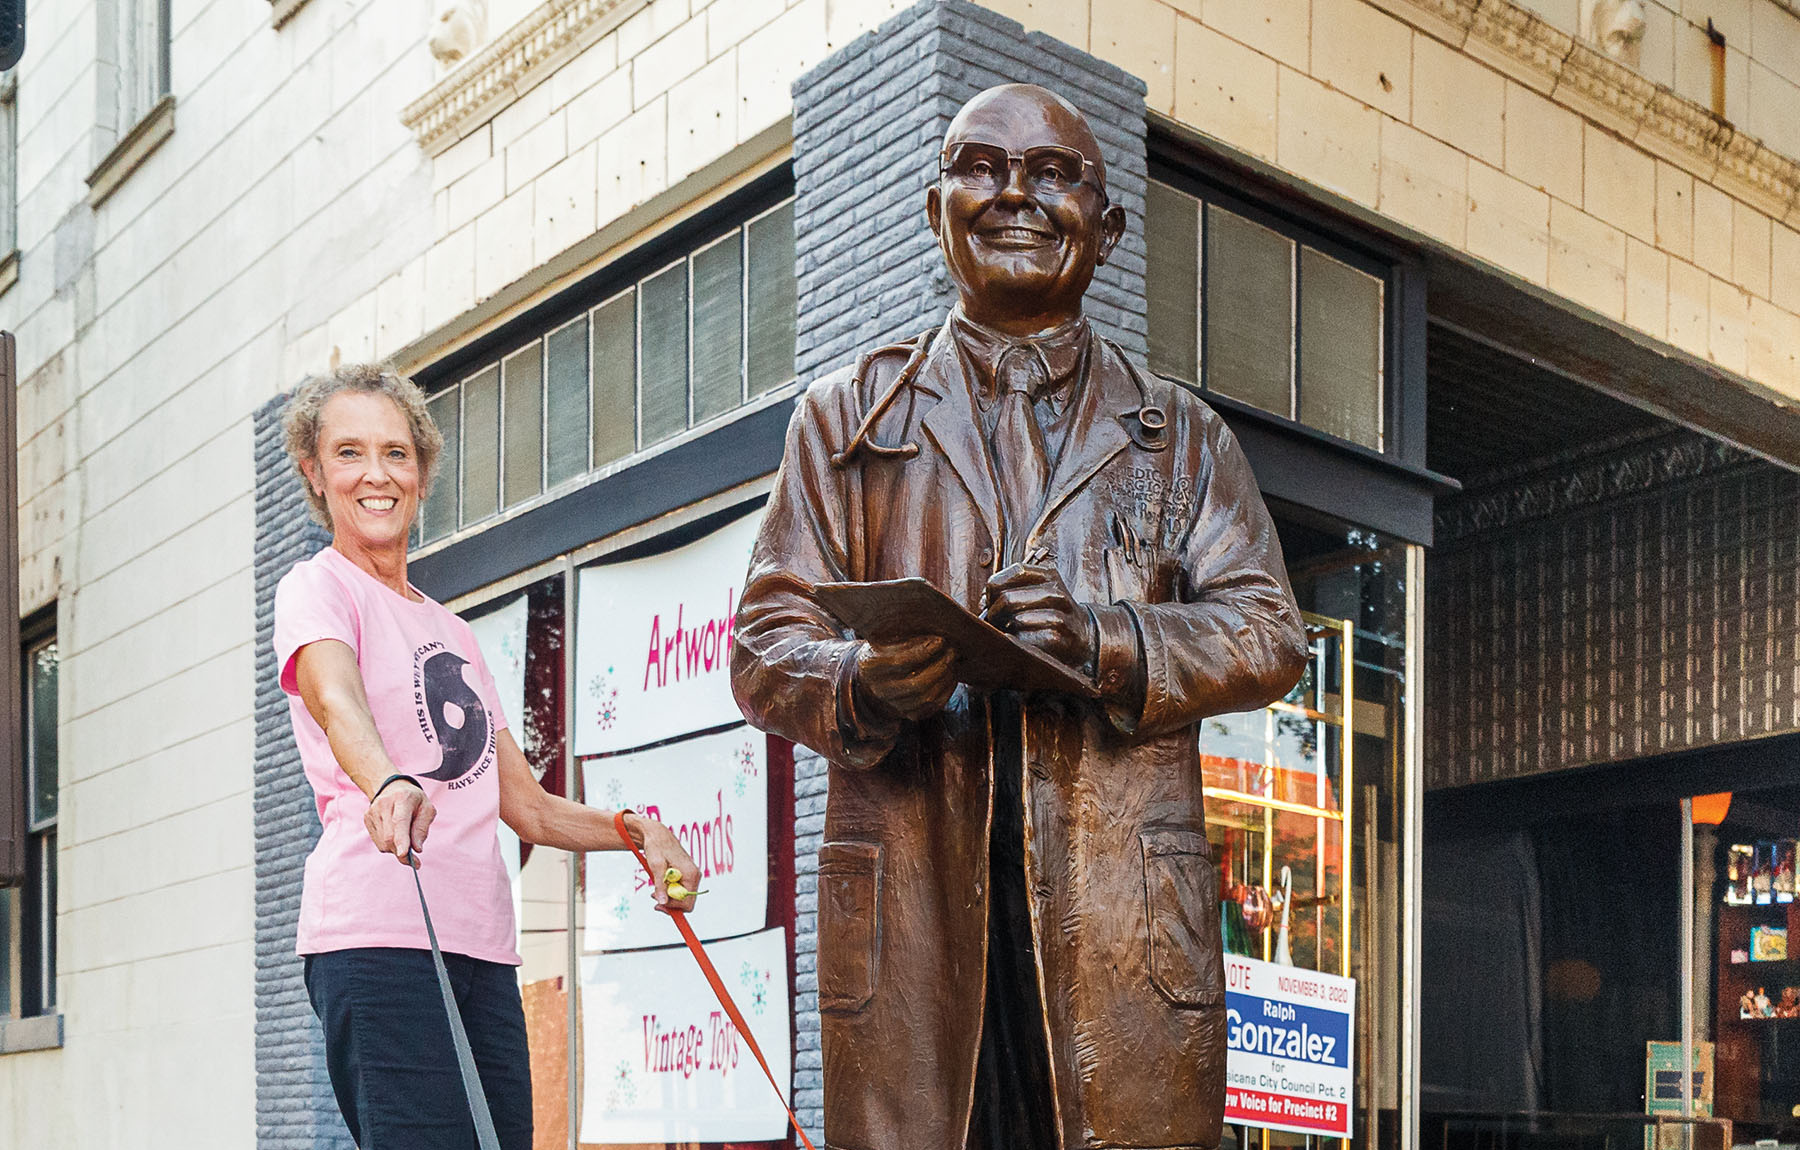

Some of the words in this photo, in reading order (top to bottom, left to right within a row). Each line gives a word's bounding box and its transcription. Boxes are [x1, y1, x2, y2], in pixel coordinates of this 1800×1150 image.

[414, 691, 423, 705] IS
[416, 708, 434, 743] THIS
[448, 776, 475, 790] HAVE
[472, 756, 492, 779] NICE
[1278, 976, 1318, 998] NOVEMBER
[1329, 987, 1348, 1004] 2020
[1263, 1000, 1296, 1022] Ralph
[642, 1014, 703, 1080] Vintage
[709, 1010, 740, 1076] Toys
[1227, 1008, 1337, 1064] Gonzalez
[1271, 1060, 1286, 1073] for
[1259, 1074, 1278, 1092] City
[1281, 1078, 1315, 1094] Council
[1318, 1083, 1336, 1097] Pct.
[1339, 1086, 1346, 1099] 2
[1240, 1092, 1266, 1113] Voice
[1268, 1096, 1282, 1114] for
[1284, 1098, 1323, 1120] Precinct
[1325, 1105, 1337, 1122] #2
